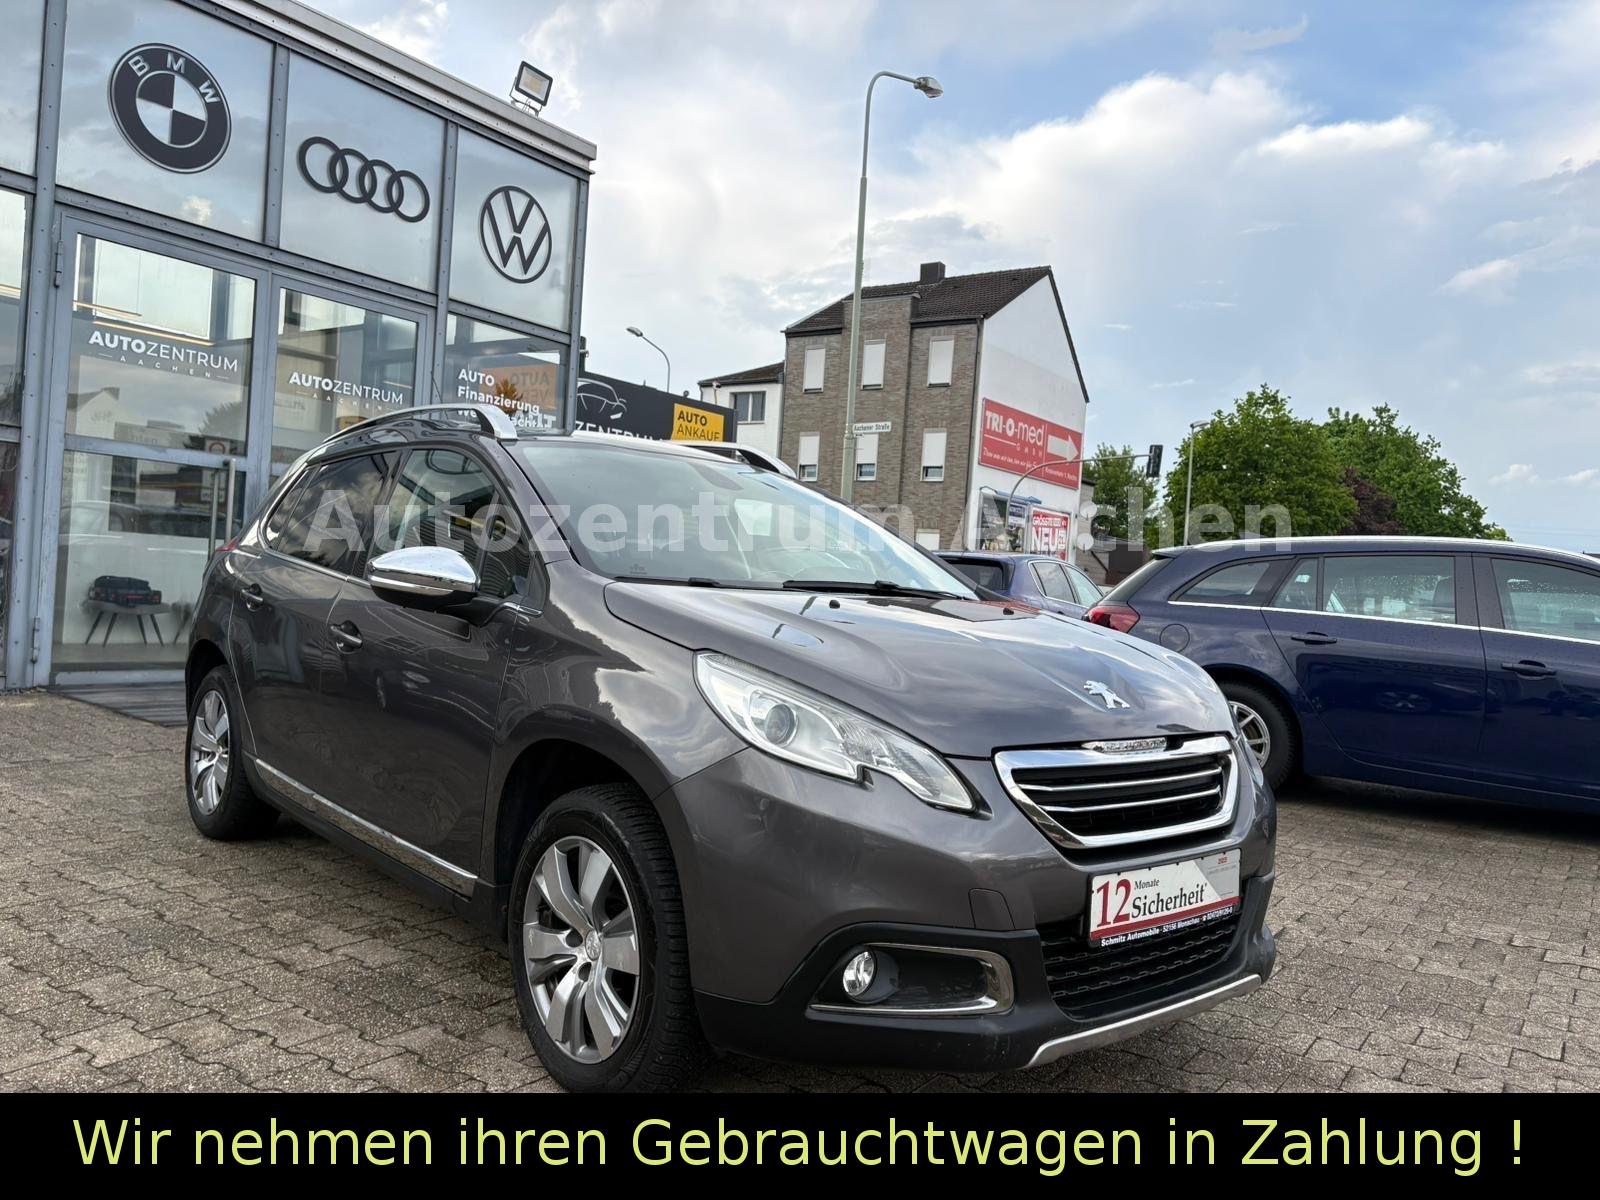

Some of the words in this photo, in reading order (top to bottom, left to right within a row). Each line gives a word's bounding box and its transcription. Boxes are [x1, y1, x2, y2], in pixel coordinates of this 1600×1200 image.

[128, 53, 220, 104] BMW
[88, 330, 239, 373] AUTOZENTRUM
[120, 355, 211, 378] AACHEN
[458, 368, 496, 387] AUTO
[289, 372, 403, 405] AUTOZENTRUM
[457, 385, 540, 416] Finanzierung
[677, 410, 707, 426] AUTO
[676, 423, 720, 442] ANKAUF
[1097, 878, 1131, 928] 12
[1134, 878, 1160, 891] Monate
[1101, 935, 1126, 947] Schmitz
[1127, 928, 1160, 941] Automobile
